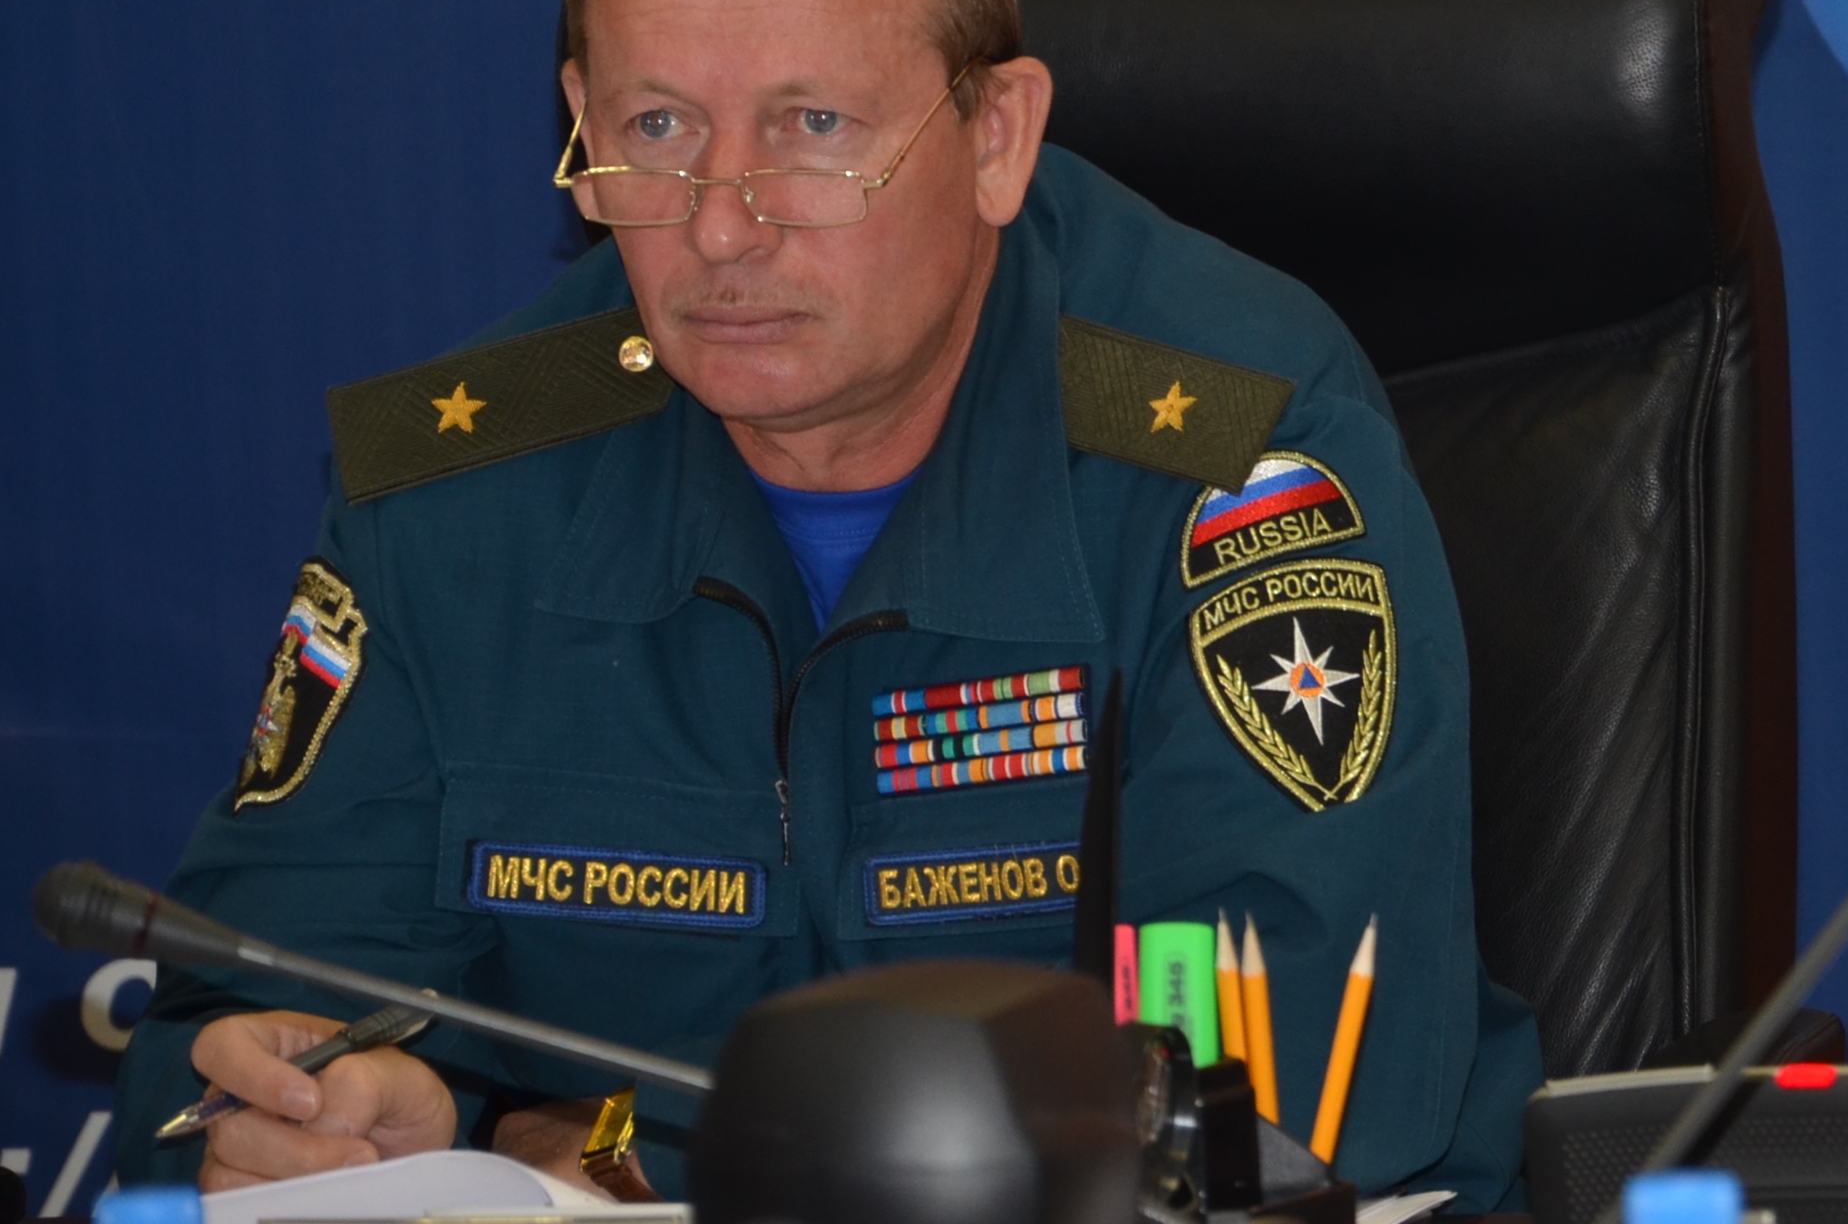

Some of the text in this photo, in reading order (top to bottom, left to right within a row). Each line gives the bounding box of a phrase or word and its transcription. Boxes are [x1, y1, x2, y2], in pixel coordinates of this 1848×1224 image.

[1213, 507, 1333, 566] RUSSIA
[1202, 571, 1375, 630] МЧС РОССИИ
[487, 855, 746, 914] МЧС РОССИИ
[878, 858, 1048, 909] БАЖЕНОВ
